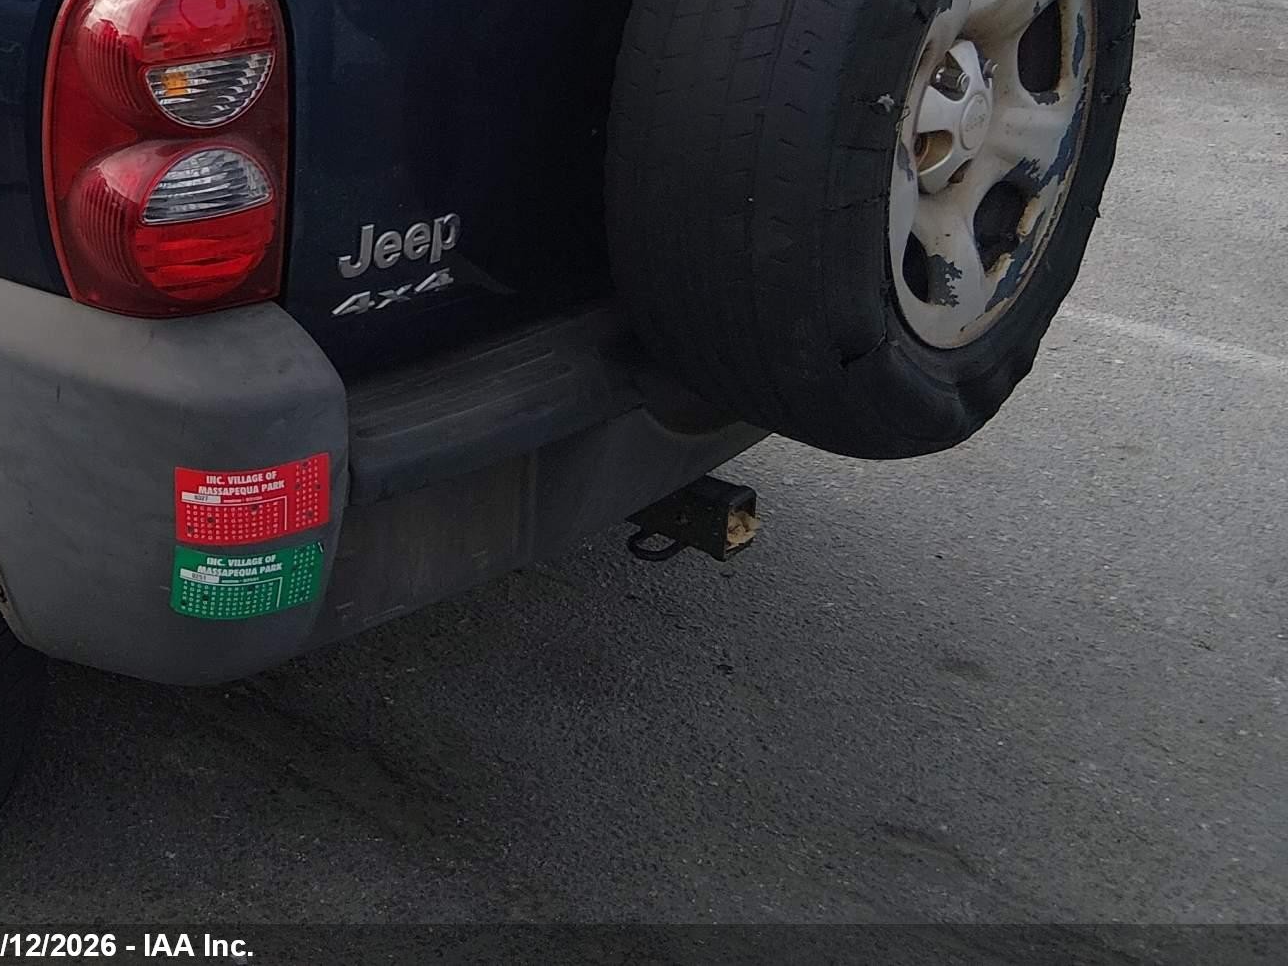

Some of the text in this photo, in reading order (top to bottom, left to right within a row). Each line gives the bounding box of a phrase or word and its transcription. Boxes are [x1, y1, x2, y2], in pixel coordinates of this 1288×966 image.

[338, 213, 461, 278] Jeep
[332, 268, 454, 315] 4x4
[228, 473, 264, 484] VILLAGE
[265, 471, 278, 480] OF
[198, 480, 285, 496] MASSAPEQUA PARK
[228, 555, 263, 566] VILLAGE
[265, 554, 277, 563] OF
[197, 562, 282, 577] MASSAPEQUA PARK
